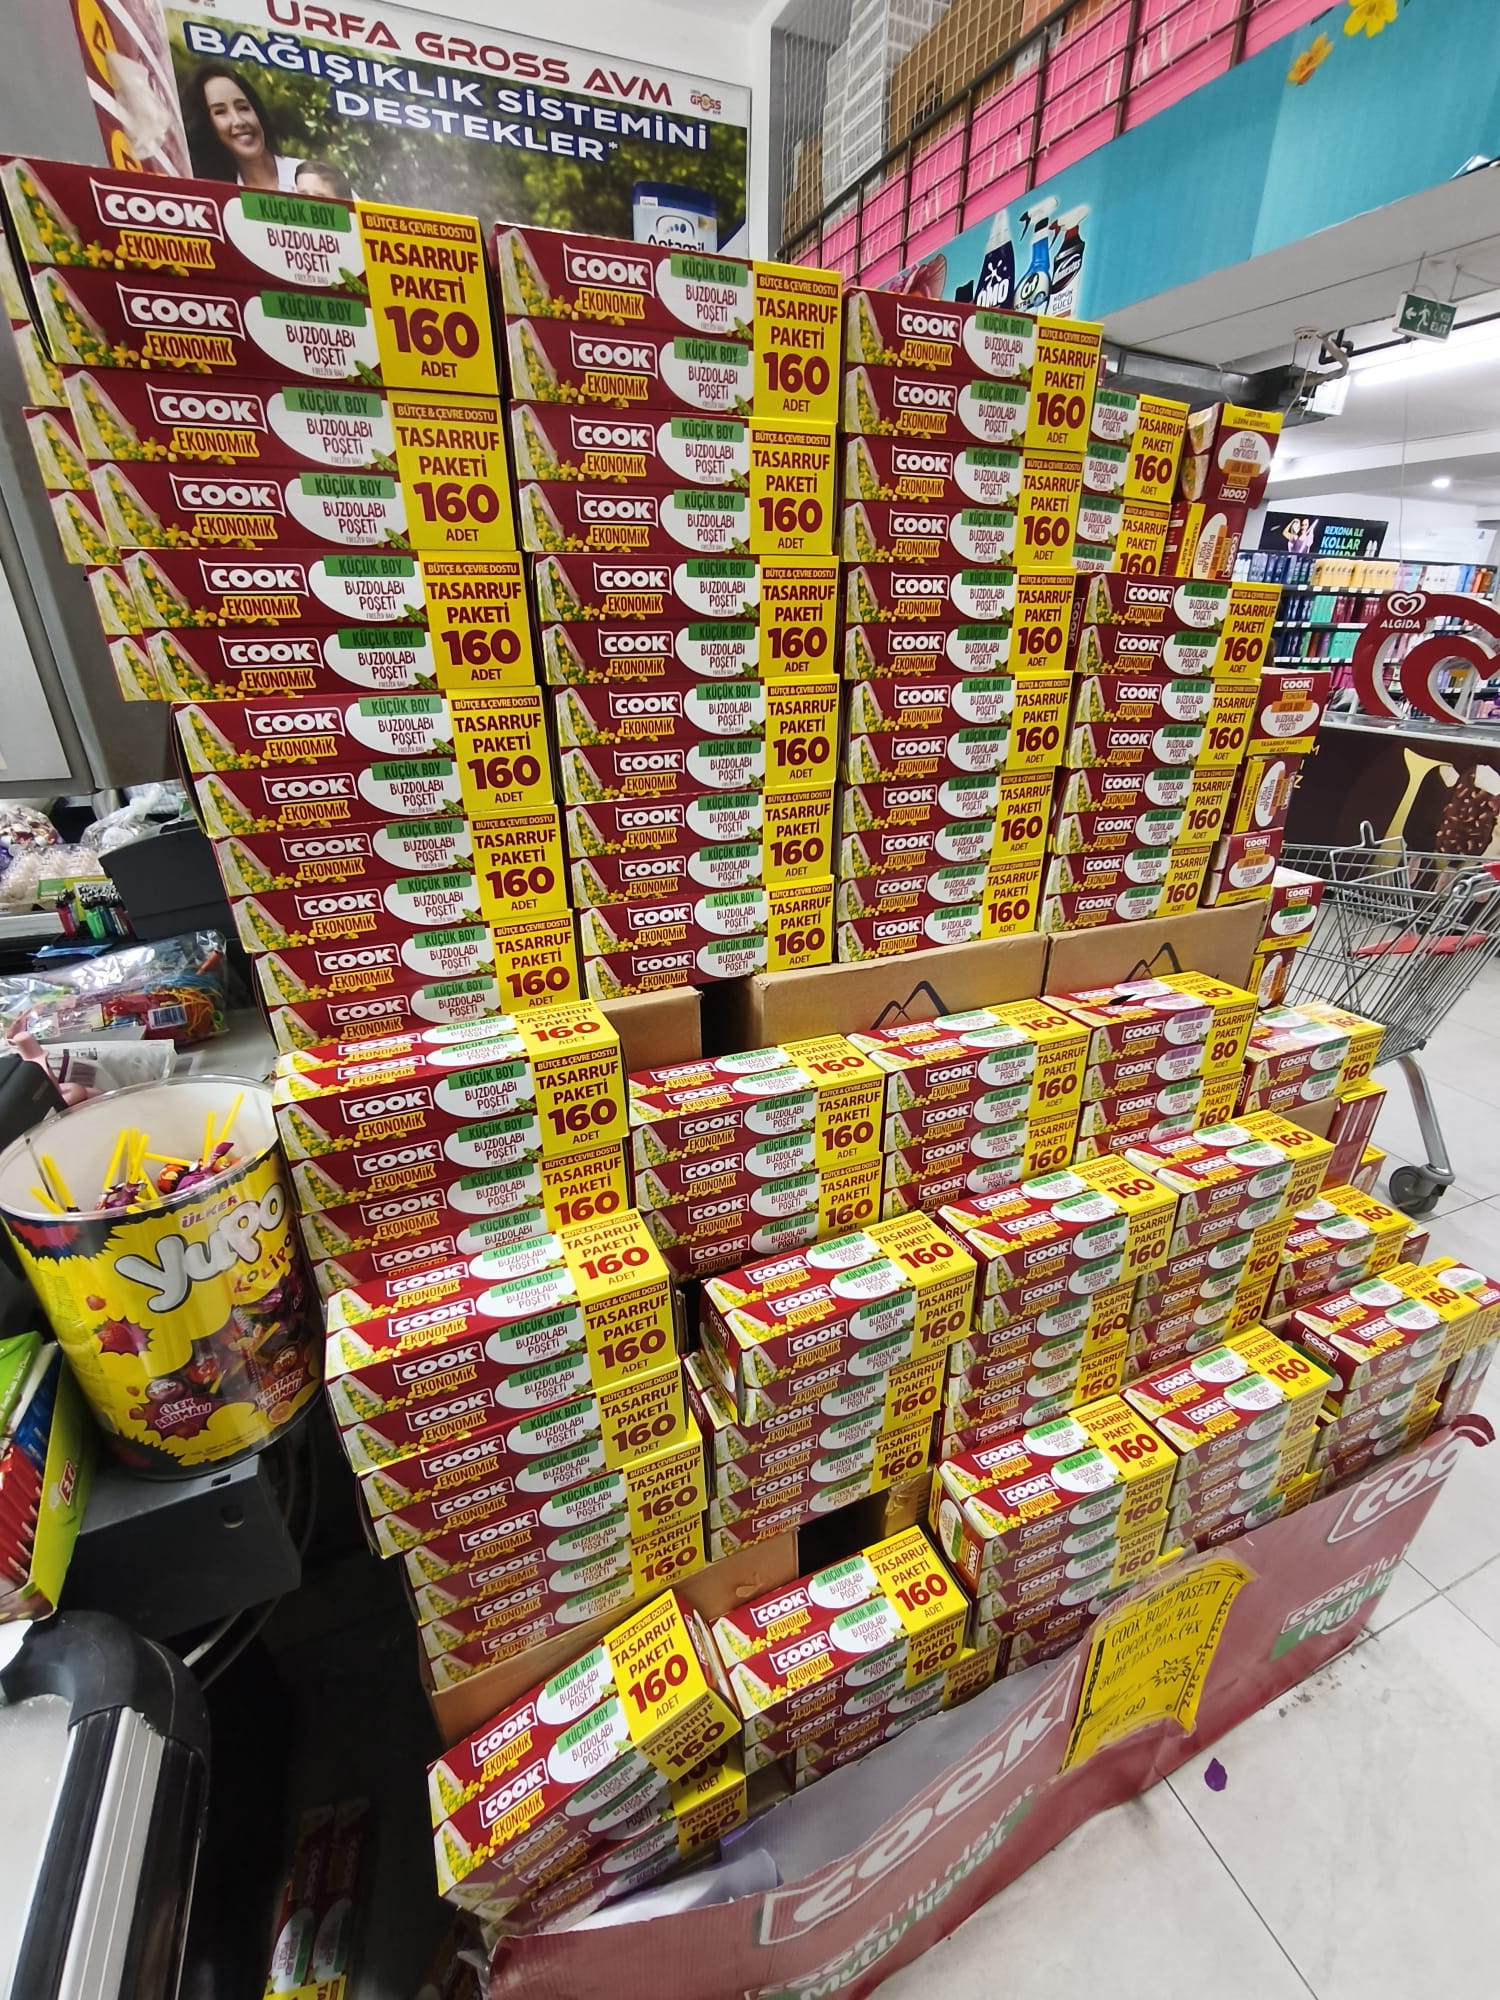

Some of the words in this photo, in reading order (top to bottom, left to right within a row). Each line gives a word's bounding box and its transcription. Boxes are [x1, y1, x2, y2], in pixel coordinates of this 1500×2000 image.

[266, 0, 401, 49] URFA
[415, 31, 570, 84] GROSS
[584, 68, 672, 106] AVM
[188, 24, 482, 106] BAĞIŞIKLIK
[498, 88, 707, 150] SİSTEMİNİ
[104, 193, 212, 229] COOK
[259, 199, 306, 225] KÜÇÜK
[311, 204, 336, 227] BOY
[366, 217, 399, 232] BÜTÇE
[400, 221, 408, 232] &
[408, 221, 438, 237] ÇEVRE
[440, 225, 473, 239] DOSTU
[124, 234, 210, 266] EKONOMİK
[267, 228, 340, 254] BUZDOLABI
[285, 251, 330, 275] POŞETİ
[365, 238, 479, 274] TASARRUF
[571, 257, 646, 286] COOK
[681, 257, 716, 279] KÜÇÜK
[719, 265, 737, 282] BOY
[390, 274, 466, 303] PAKETİ
[686, 284, 738, 306] BUZDOLABI
[759, 276, 783, 290] BÜTÇE
[813, 284, 837, 297] DOSTU
[131, 297, 233, 328] COOK
[279, 296, 323, 321] KÜÇÜK
[327, 302, 351, 320] BOY
[581, 291, 643, 316] EKONOMİK
[696, 305, 728, 325] POŞETİ
[756, 296, 838, 325] TASARRUF
[286, 324, 356, 348] BUZDOLABI
[384, 306, 480, 359] 160
[770, 325, 825, 350] PAKETİ
[901, 314, 957, 339] COOK
[150, 335, 230, 363] EKONOMİK
[304, 346, 346, 367] POŞETİ
[906, 341, 951, 363] EKONOMİK
[984, 336, 1023, 354] BUZDOLABI
[1038, 346, 1097, 369] TASARRUF
[421, 360, 457, 377] ADET
[763, 352, 830, 395] 160
[1044, 370, 1086, 391] PAKETİ
[159, 396, 257, 422] COOK
[782, 398, 810, 413] ADET
[1036, 392, 1086, 429] 160
[396, 426, 500, 451] TASARRUF
[1046, 432, 1068, 444] ADET
[1138, 417, 1185, 438] TASARRUF
[1142, 436, 1174, 455] PAKETİ
[419, 454, 487, 477] PAKETİ
[1134, 453, 1173, 484] 160
[413, 482, 500, 523] 160
[446, 529, 479, 541] ADET
[1321, 536, 1360, 550] KOLLAR
[601, 571, 665, 588] COOK
[700, 581, 745, 594] BUZDOLABI
[895, 578, 945, 595] COOK
[608, 596, 661, 612] EKONOMİK
[763, 584, 835, 601] TASARRUF
[1017, 589, 1072, 604] TASARRUF
[1128, 586, 1171, 604] COOK
[775, 603, 822, 621] PAKETİ
[1024, 606, 1062, 623] PAKETİ
[1229, 602, 1276, 618] TASARRUF
[1232, 618, 1266, 634] PAKETİ
[767, 626, 828, 659] 160
[1017, 626, 1063, 655] 160
[1224, 636, 1264, 663] 160
[784, 661, 809, 673] ADET
[1282, 680, 1311, 690] COOK
[371, 697, 405, 715] KÜÇÜK
[409, 696, 431, 712] BOY
[255, 713, 334, 733] COOK
[378, 717, 434, 734] BUZDOLABI
[454, 713, 542, 734] TASARRUF
[270, 738, 336, 757] EKONOMİK
[391, 730, 426, 746] POŞETİ
[473, 731, 531, 754] PAKETİ
[467, 755, 541, 790] 160
[494, 791, 524, 804] ADET
[1077, 897, 1115, 912] COOK
[1166, 882, 1198, 904] 160
[633, 908, 690, 927] COOK
[770, 896, 830, 916] TASARRUF
[987, 899, 1031, 924] 160
[876, 920, 921, 935] COOK
[774, 927, 825, 956] 160
[1209, 1040, 1238, 1061] 80
[459, 1067, 492, 1088] KÜÇÜK
[495, 1064, 515, 1080] BOY
[536, 1060, 620, 1090] TASARRUF
[929, 1063, 975, 1085] COOK
[465, 1081, 518, 1101] BUZDOLABI
[553, 1079, 608, 1105] PAKETİ
[1037, 1074, 1077, 1100] 160
[349, 1090, 426, 1120] COOK
[818, 1091, 881, 1112] TASARRUF
[362, 1113, 425, 1138] EKONOMİK
[547, 1098, 618, 1136] 160
[684, 1113, 738, 1135] COOK
[572, 1130, 600, 1145] ADET
[821, 1121, 874, 1151] 160
[1107, 1178, 1156, 1199] 160
[181, 1194, 237, 1228] ÜLKER
[564, 1221, 642, 1250] TASARRUF
[579, 1246, 650, 1280] 160
[900, 1242, 953, 1268] 160
[586, 1294, 669, 1330] TASARRUF
[775, 1287, 829, 1313] COOK
[603, 1313, 658, 1341] PAKETİ
[597, 1328, 667, 1369] 160
[402, 1346, 477, 1380] COOK
[1267, 1359, 1310, 1383] 160
[414, 1367, 475, 1396] EKONOMİK
[155, 1402, 211, 1429] AROMALI
[1085, 1409, 1133, 1433] TASARRUF
[1103, 1423, 1138, 1441] PAKETİ
[980, 1442, 1025, 1467] COOK
[1109, 1433, 1158, 1464] 160
[874, 1543, 930, 1576] TASARRUF
[892, 1558, 931, 1586] PAKETİ
[894, 1573, 948, 1613] 160
[1290, 1576, 1362, 1625] COOK
[757, 1591, 805, 1622] COOK
[612, 1613, 679, 1669] TASARRUF
[629, 1633, 674, 1679] PAKETİ
[628, 1653, 689, 1714] 160
[656, 1695, 679, 1720] ADET
[476, 1709, 533, 1758] COOK
[484, 1734, 532, 1777] EKONOMİK
[793, 1678, 1067, 1922] COOK
